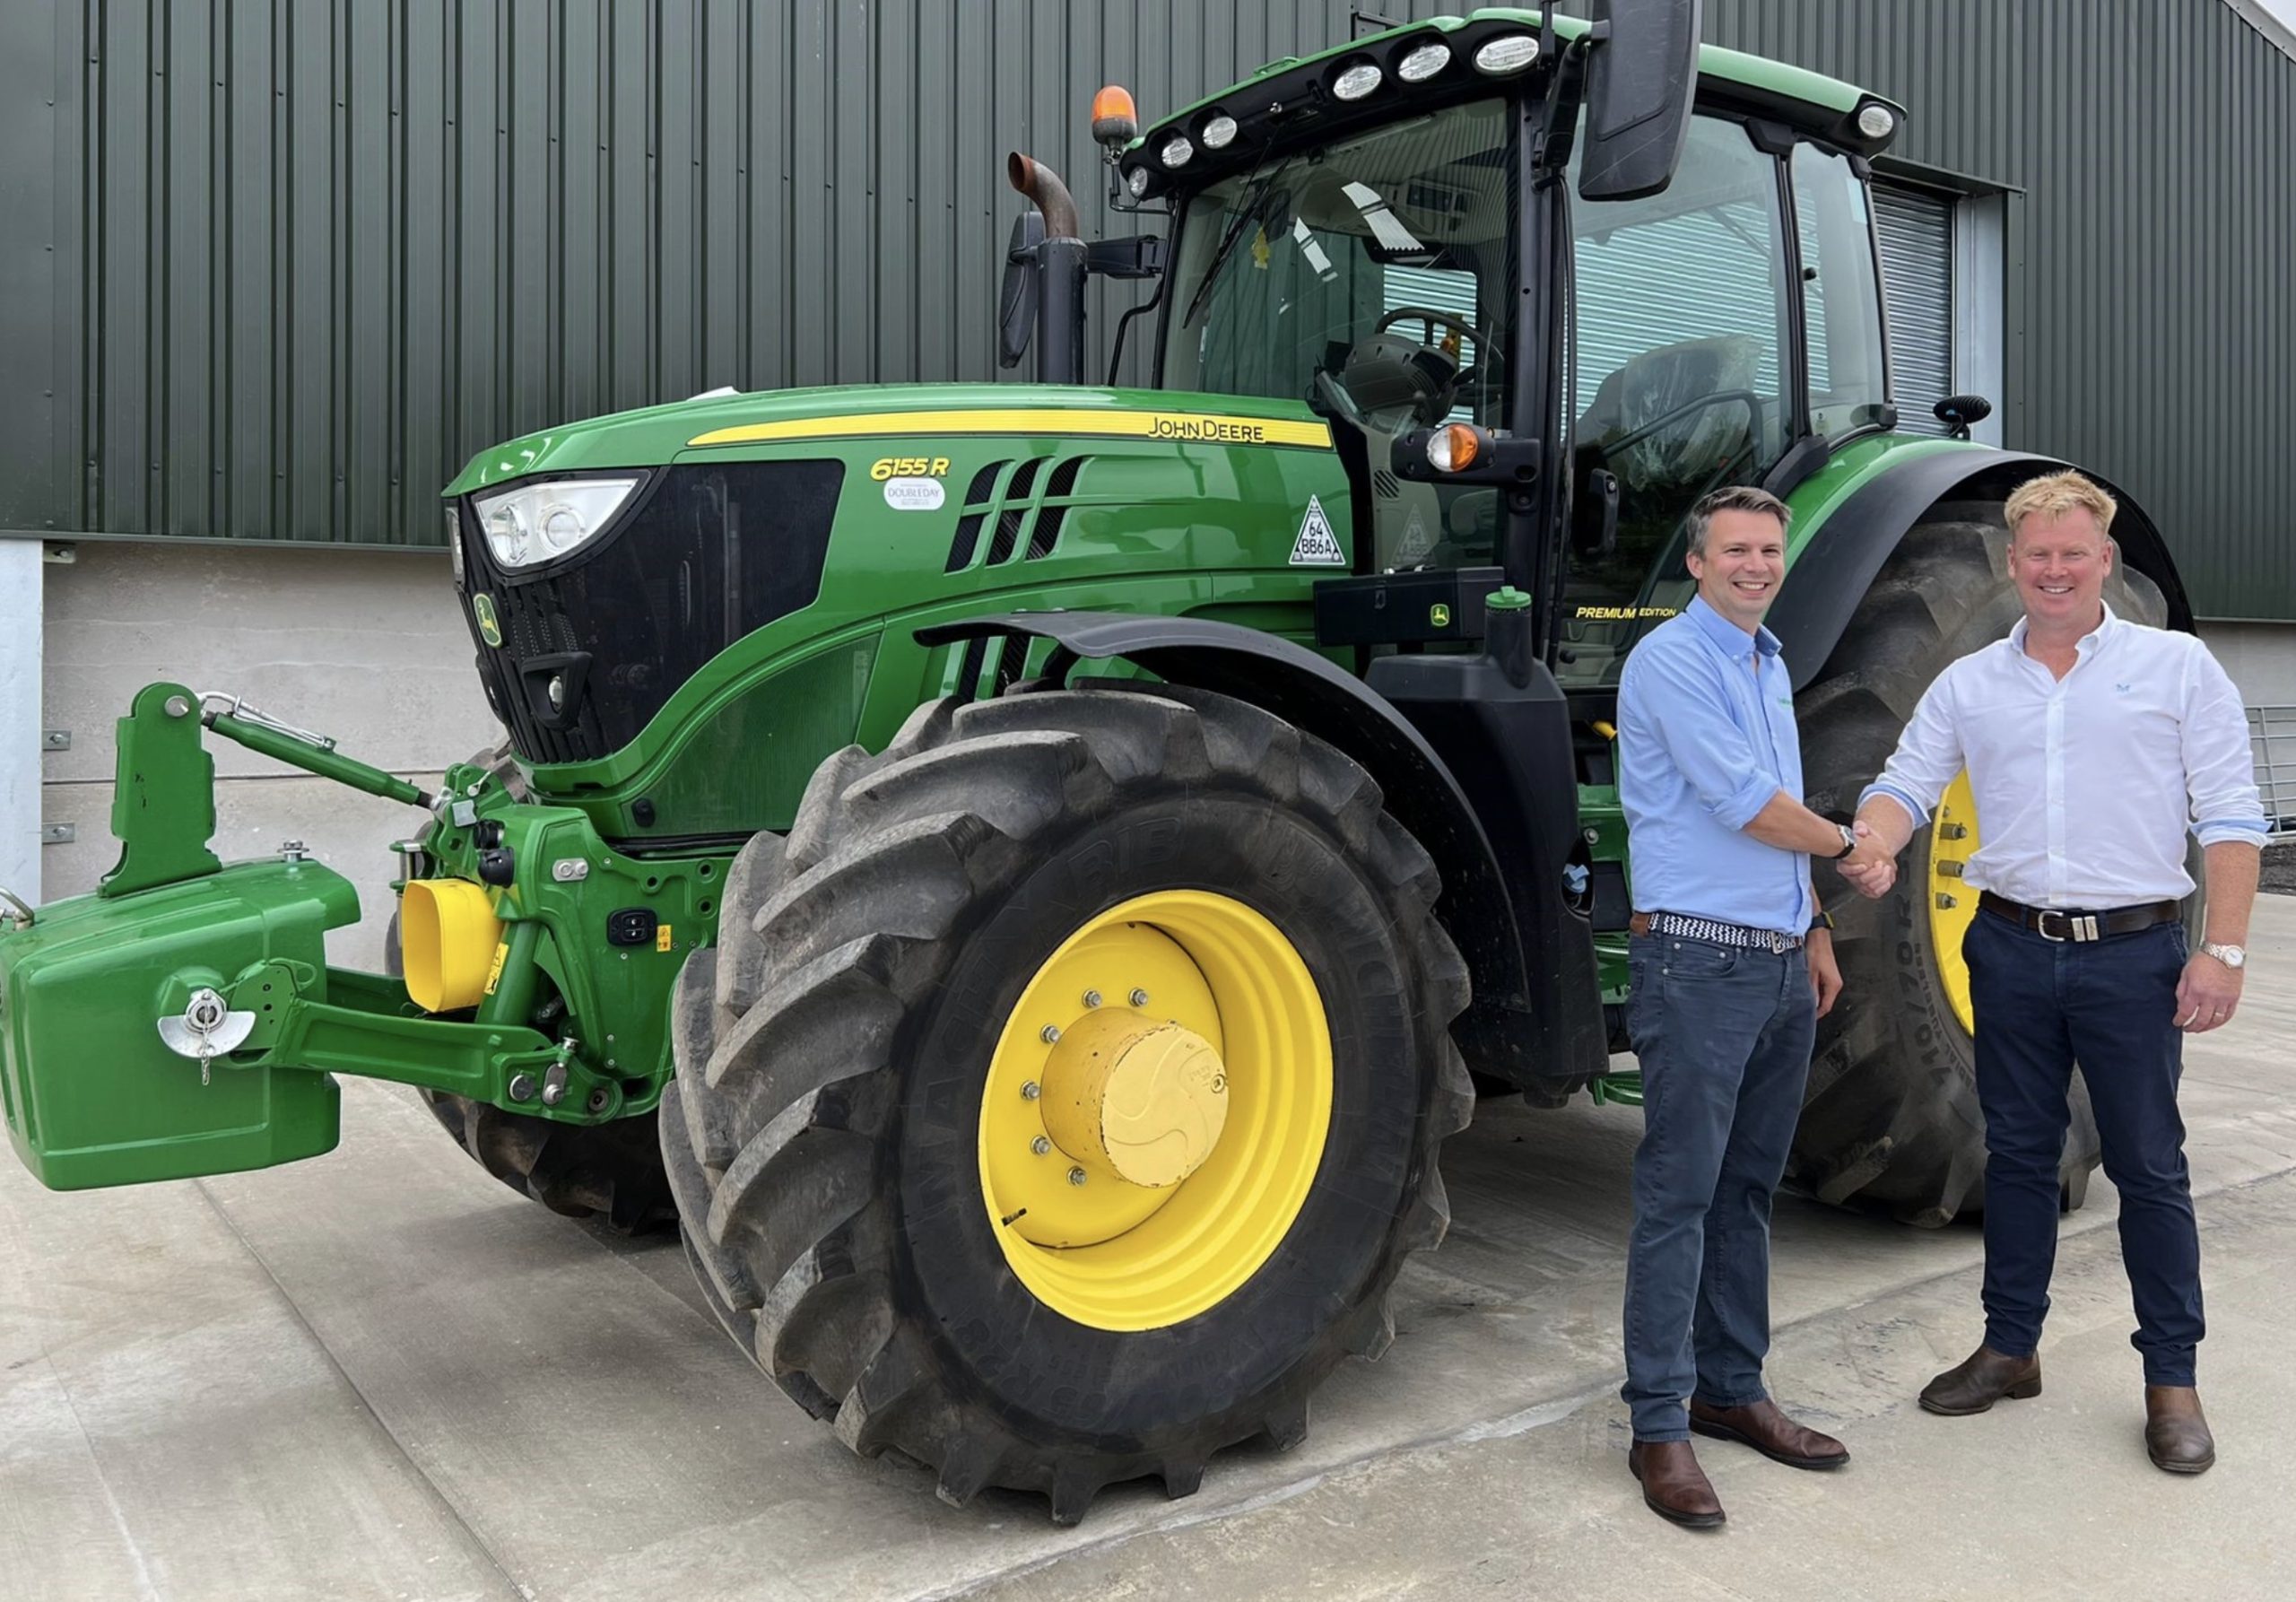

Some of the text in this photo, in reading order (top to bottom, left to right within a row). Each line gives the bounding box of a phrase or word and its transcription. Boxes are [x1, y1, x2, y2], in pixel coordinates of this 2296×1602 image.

[1148, 416, 1265, 441] JOHN DEERE
[870, 457, 951, 481] 6155 R
[887, 487, 940, 498] DOUBLEDAY
[1309, 521, 1323, 536] 64
[1301, 538, 1332, 554] BB6A
[1576, 606, 1676, 619] PREMIUM EDITION
